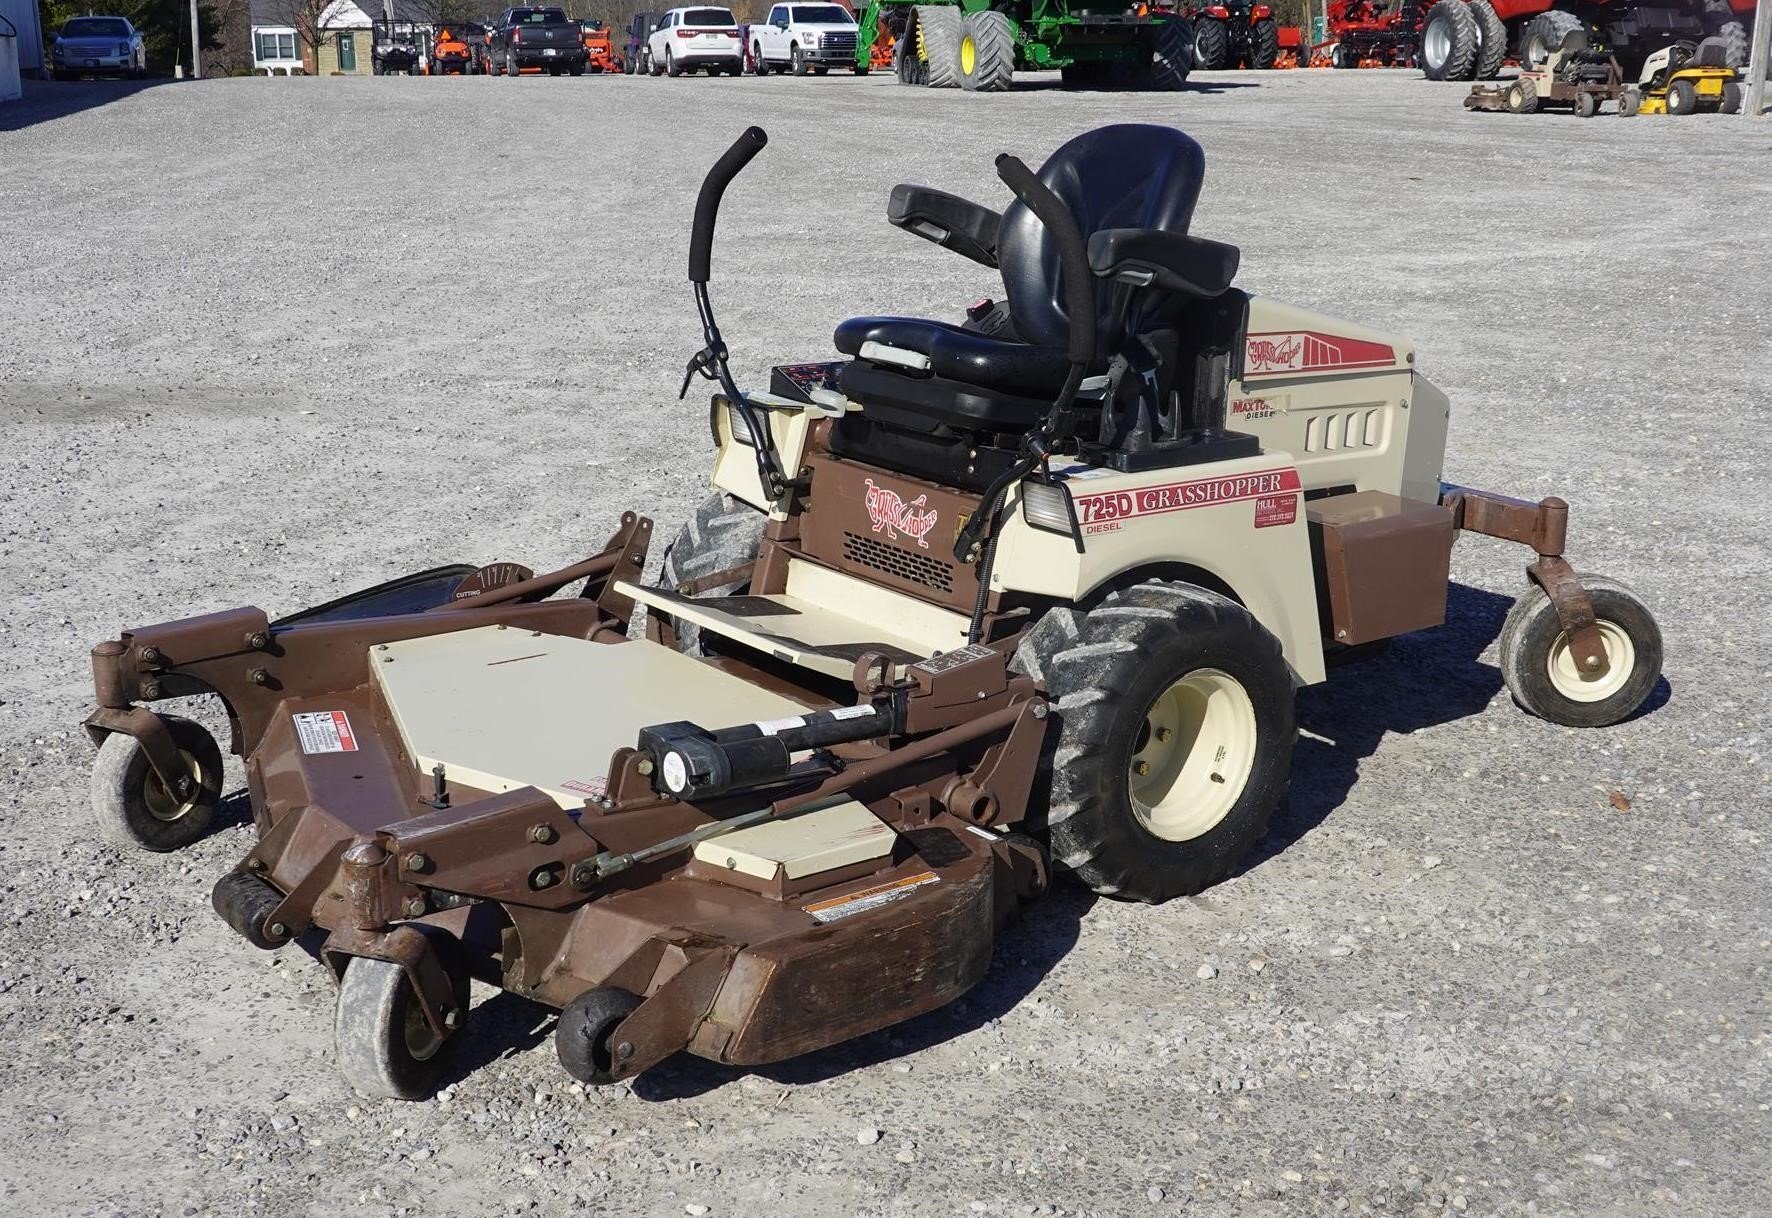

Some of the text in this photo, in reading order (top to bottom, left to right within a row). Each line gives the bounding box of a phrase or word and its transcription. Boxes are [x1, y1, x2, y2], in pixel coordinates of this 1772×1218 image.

[1079, 474, 1282, 522] 725D GRASSHOPPER
[1086, 522, 1122, 535] DIESEL
[456, 589, 481, 599] CUTTING
